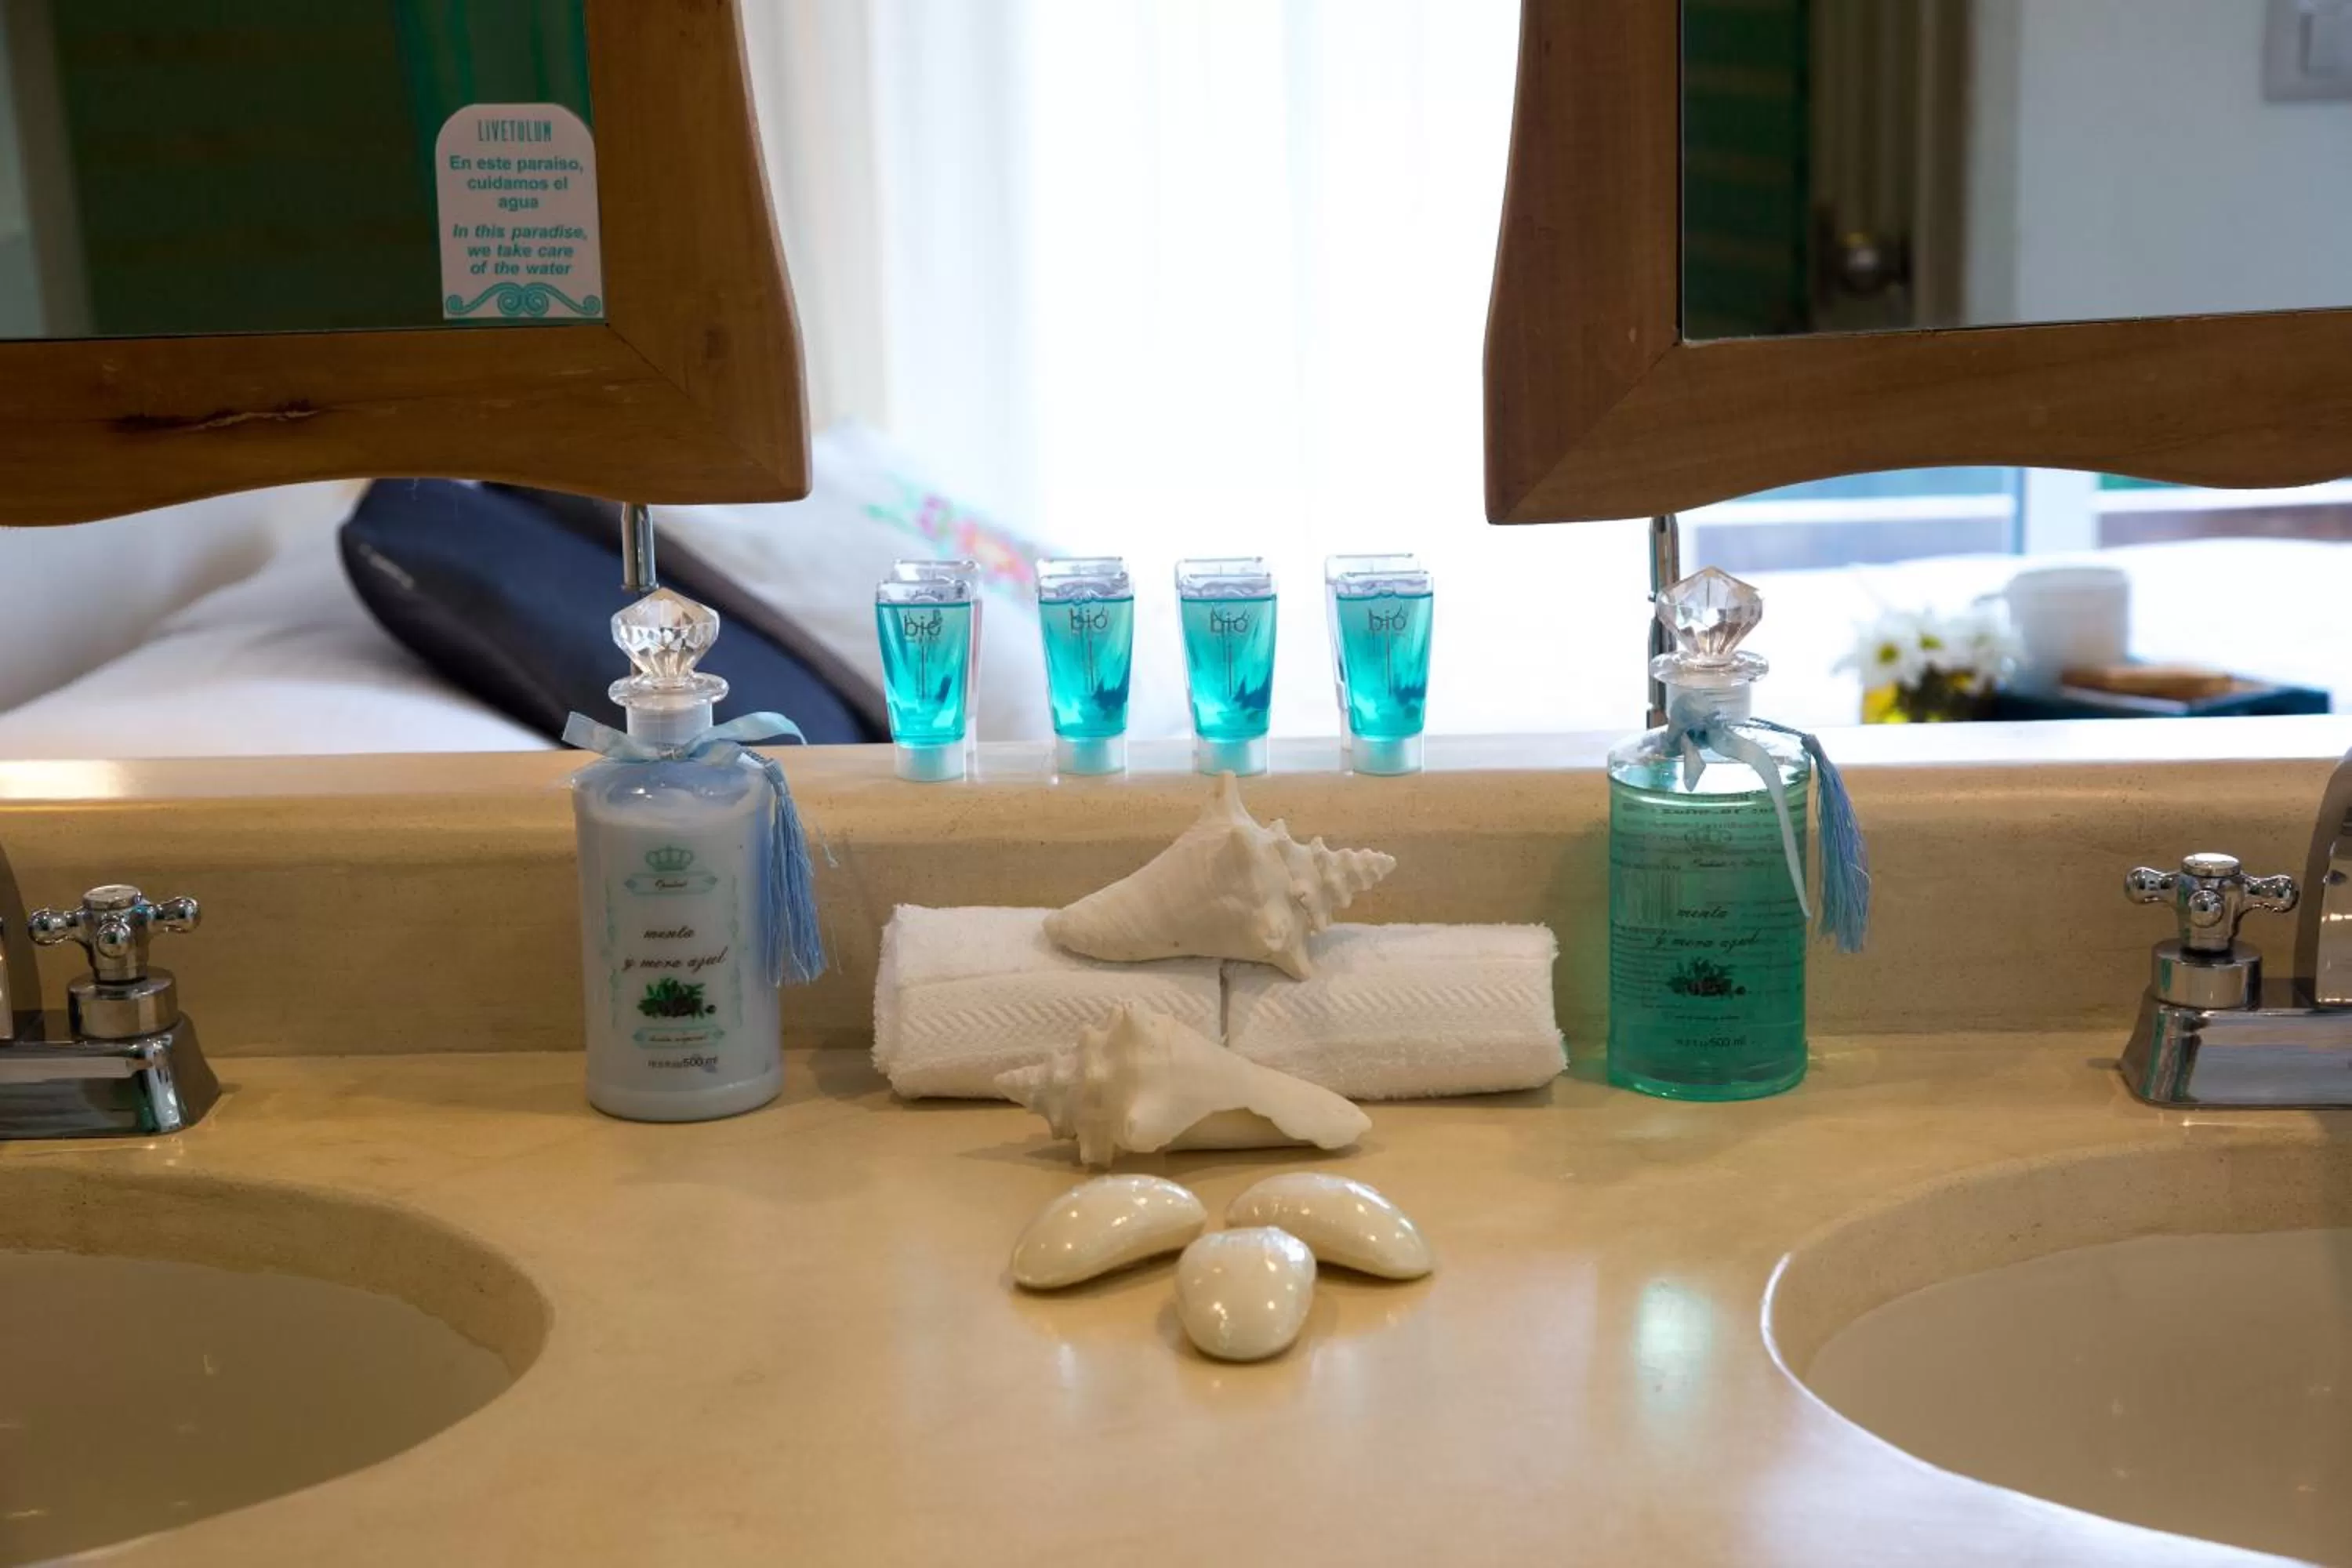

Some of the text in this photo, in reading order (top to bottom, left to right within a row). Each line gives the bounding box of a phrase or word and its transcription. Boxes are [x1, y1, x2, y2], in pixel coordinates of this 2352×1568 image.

[450, 155, 471, 169] En
[477, 157, 511, 169] este
[467, 176, 568, 190] cuidamos el
[498, 198, 539, 211] agua
[452, 224, 588, 241] In this paradise,
[467, 245, 575, 257] we take care
[470, 261, 573, 274] of the water
